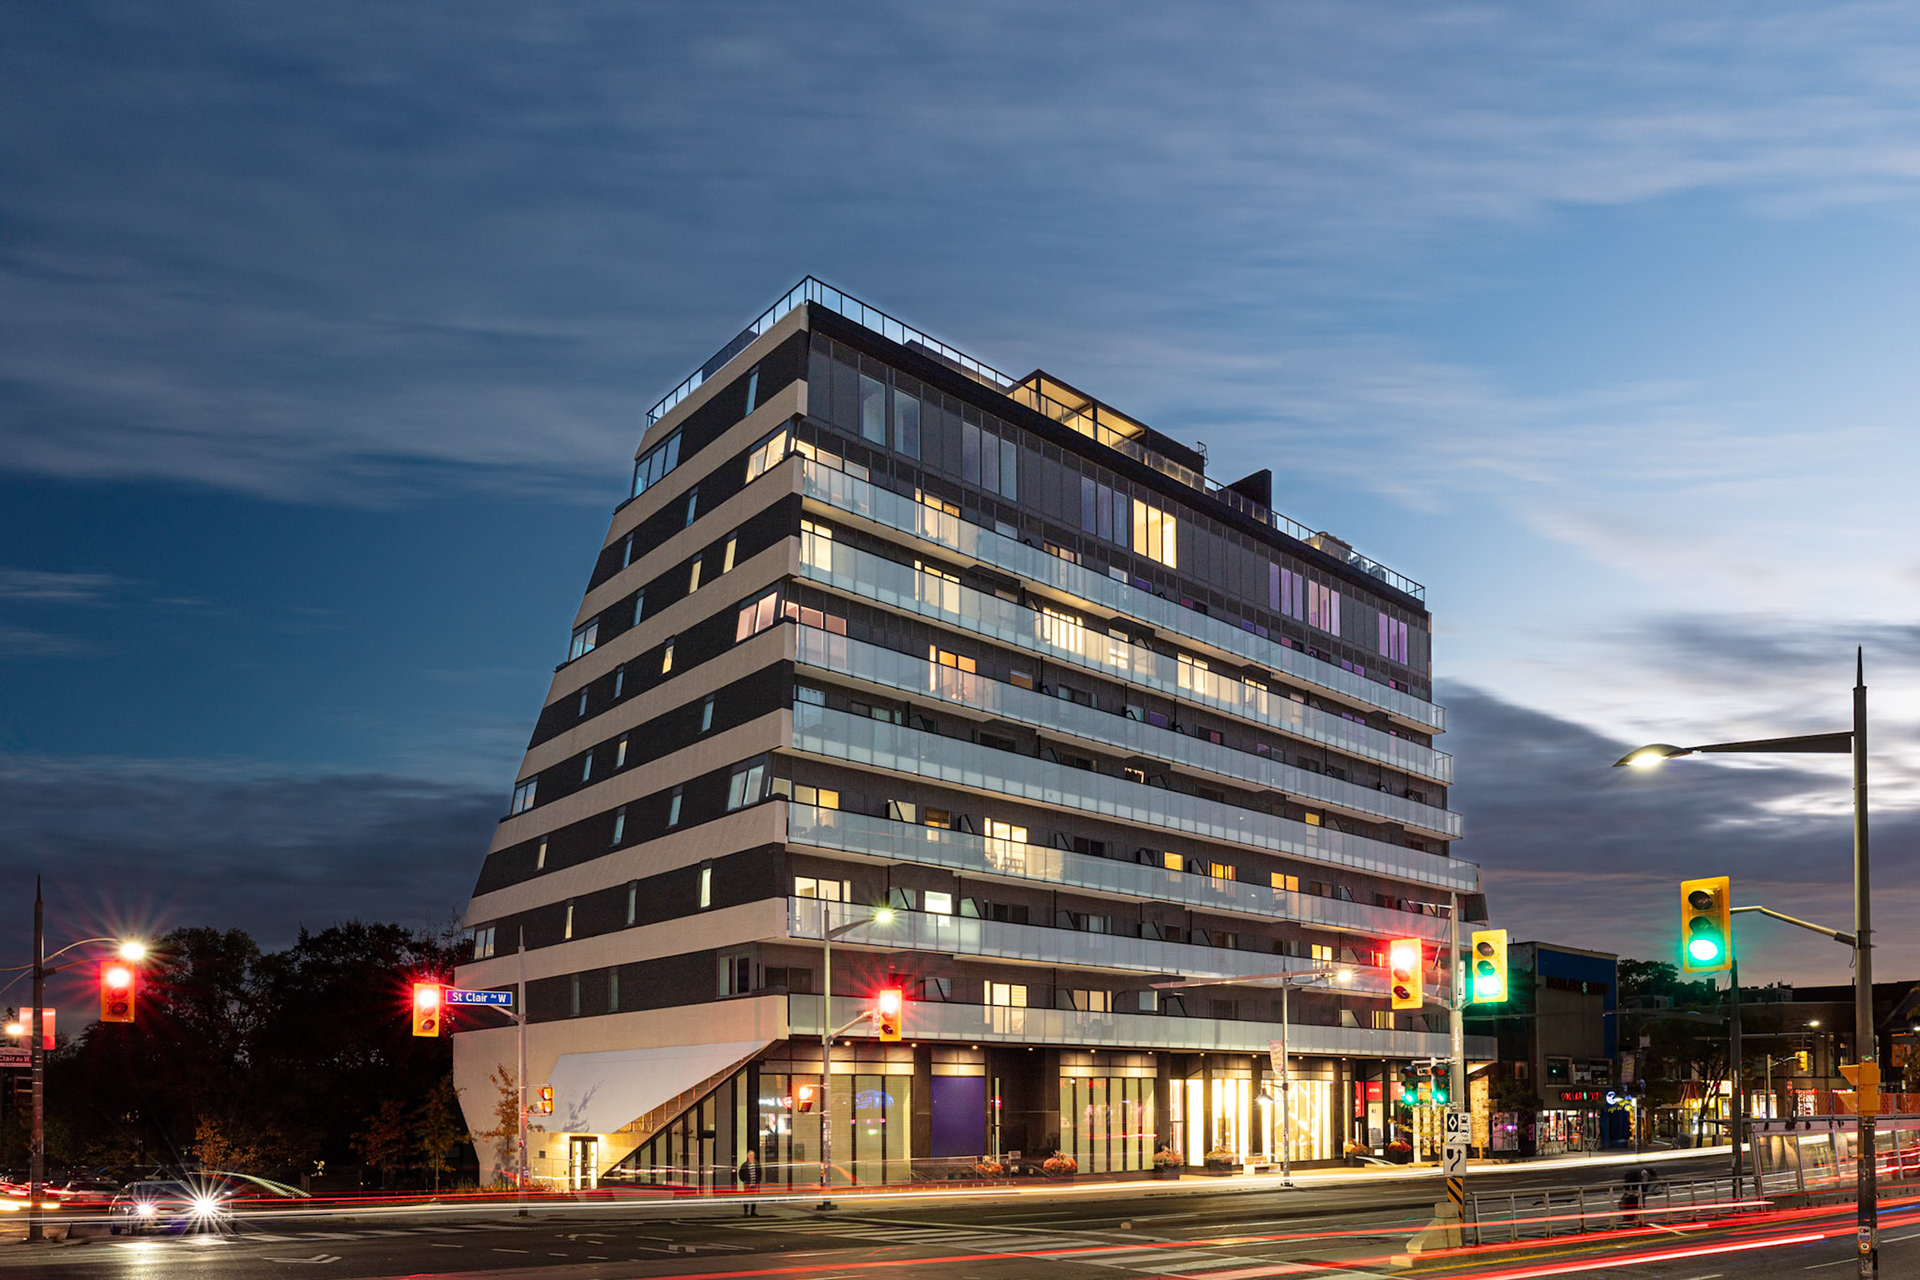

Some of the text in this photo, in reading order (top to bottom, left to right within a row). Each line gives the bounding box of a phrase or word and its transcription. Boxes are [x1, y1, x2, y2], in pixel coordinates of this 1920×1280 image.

[452, 992, 463, 1002] St
[465, 992, 488, 1003] Clair
[498, 994, 507, 1003] W
